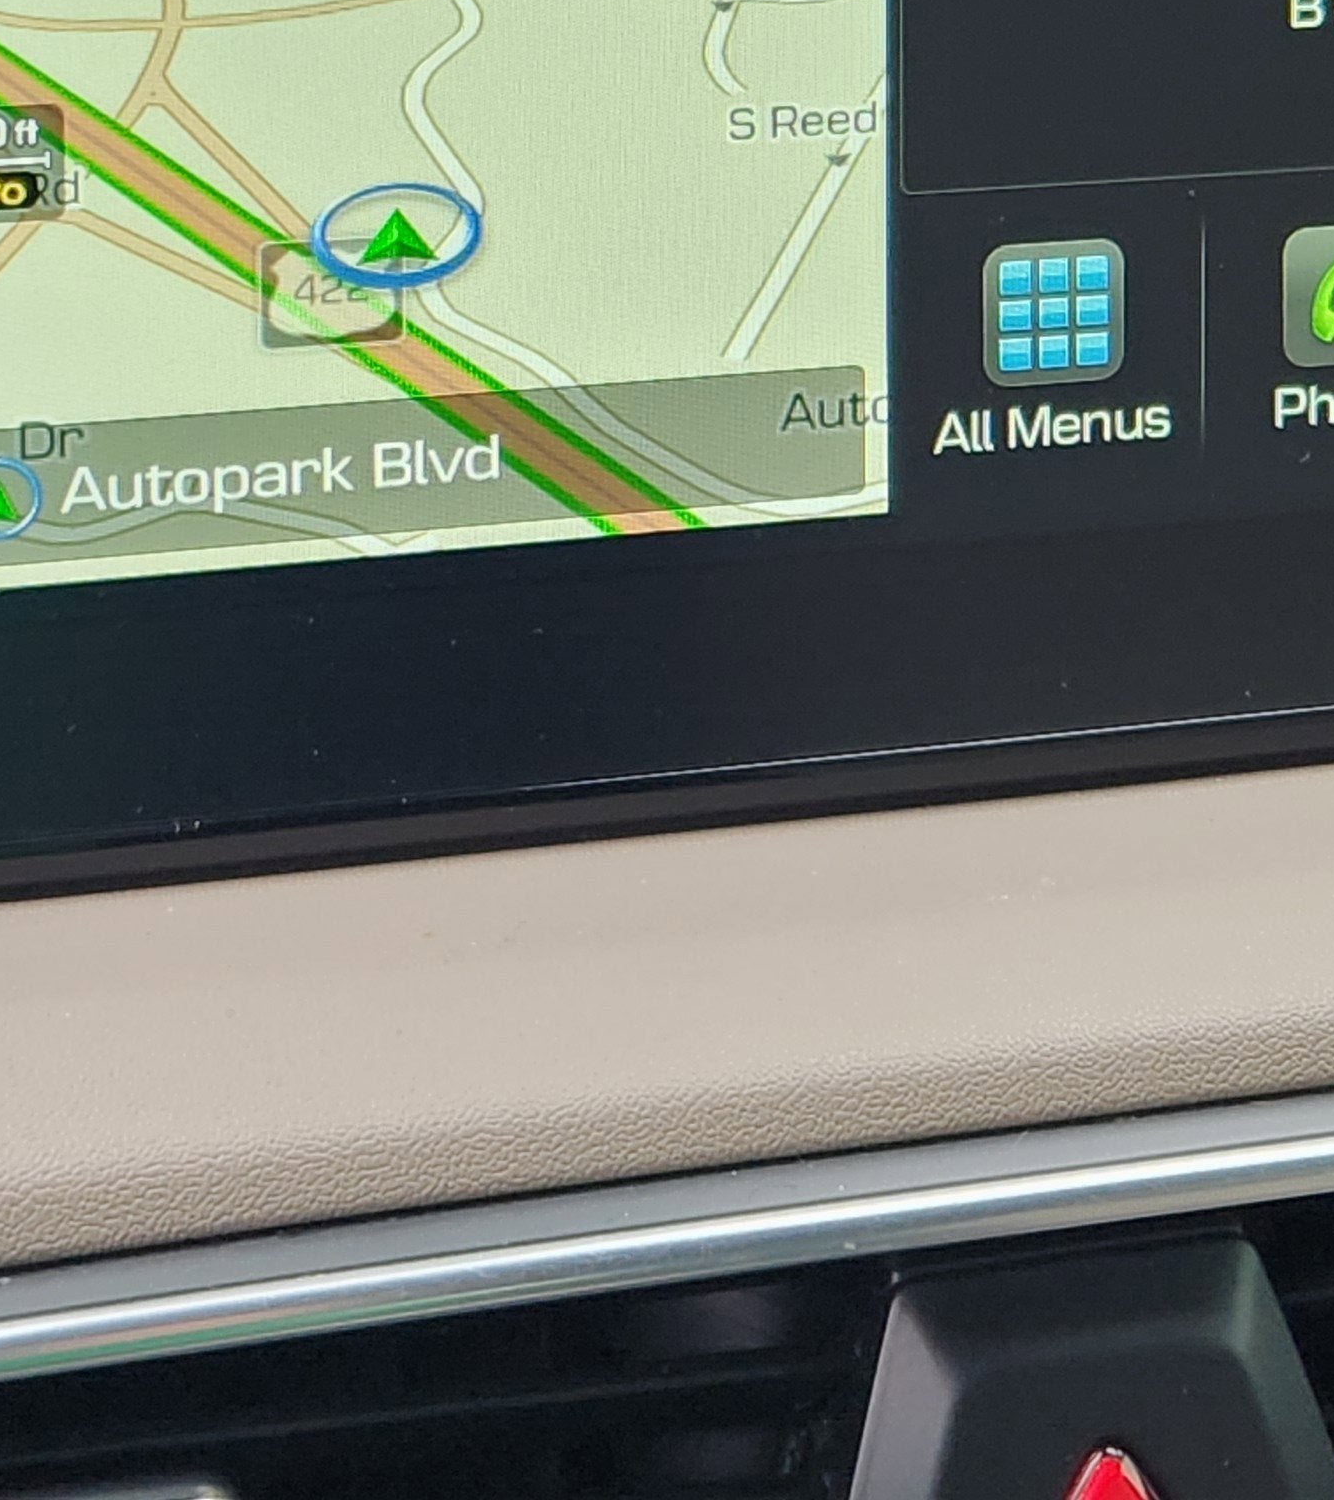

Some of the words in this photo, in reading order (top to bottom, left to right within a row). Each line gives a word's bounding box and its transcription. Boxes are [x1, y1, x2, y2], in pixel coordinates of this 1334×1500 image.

[729, 106, 757, 141] S
[771, 100, 877, 139] Reed
[19, 420, 85, 460] Dr
[932, 408, 996, 456] All
[1007, 402, 1173, 450] Menus
[60, 446, 356, 514] Autopark
[372, 433, 502, 490] Blvd
